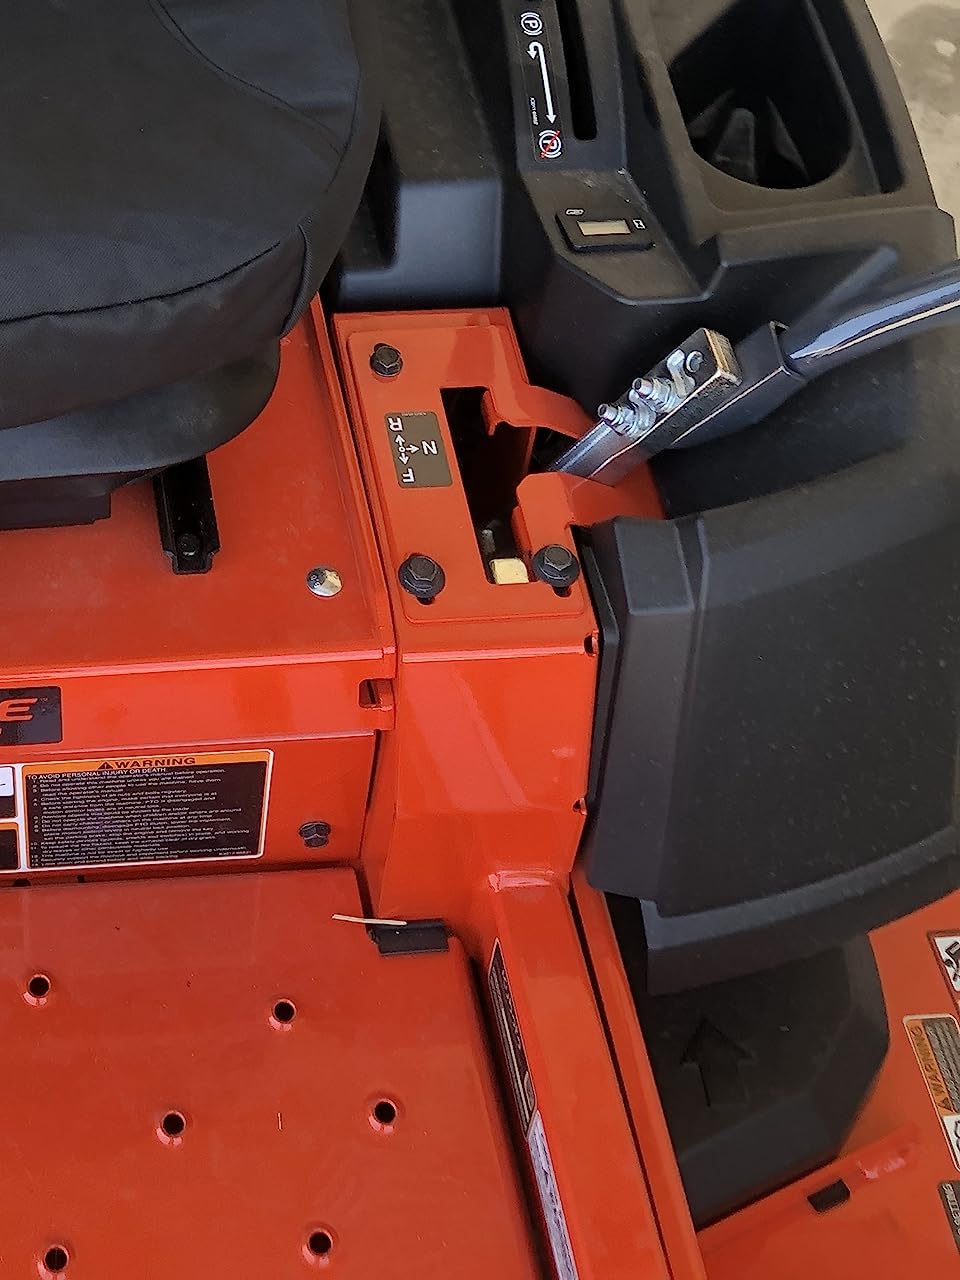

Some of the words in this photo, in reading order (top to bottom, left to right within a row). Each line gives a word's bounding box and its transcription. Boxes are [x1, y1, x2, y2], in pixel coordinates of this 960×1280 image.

[387, 417, 403, 431] R
[422, 440, 438, 455] N
[402, 468, 415, 483] F
[115, 757, 196, 768] WARNING
